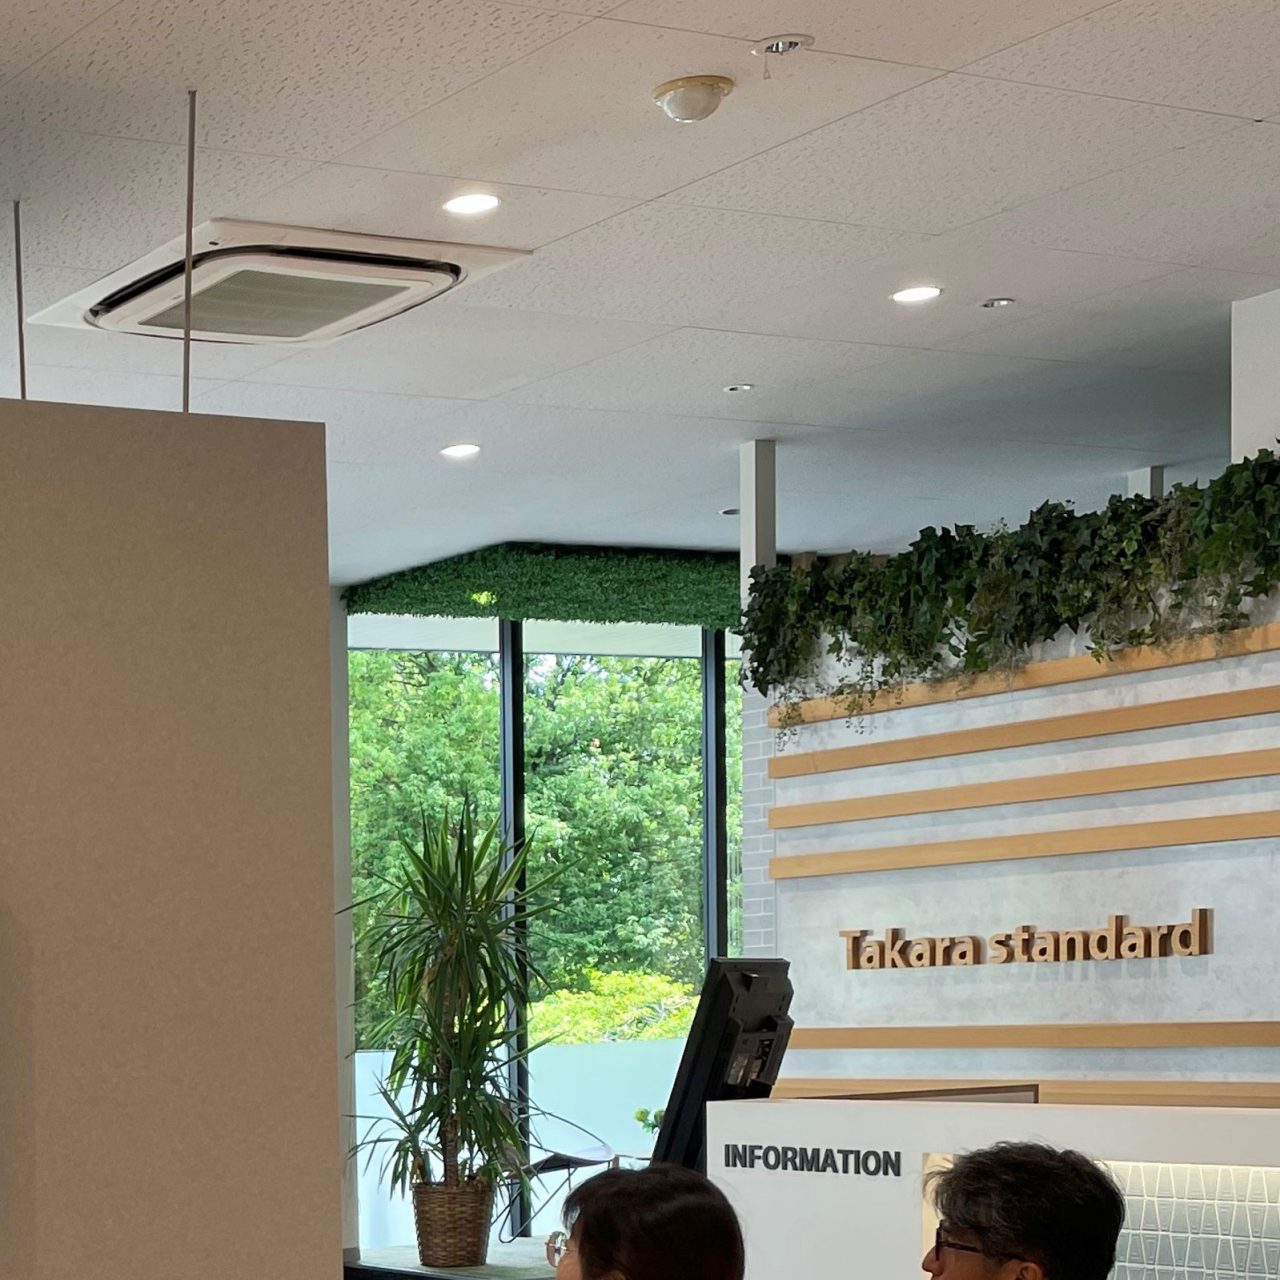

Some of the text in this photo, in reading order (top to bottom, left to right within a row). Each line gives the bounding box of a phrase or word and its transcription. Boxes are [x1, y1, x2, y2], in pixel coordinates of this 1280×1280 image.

[839, 908, 1215, 970] Takara standard
[724, 1144, 901, 1177] INFORMATION
